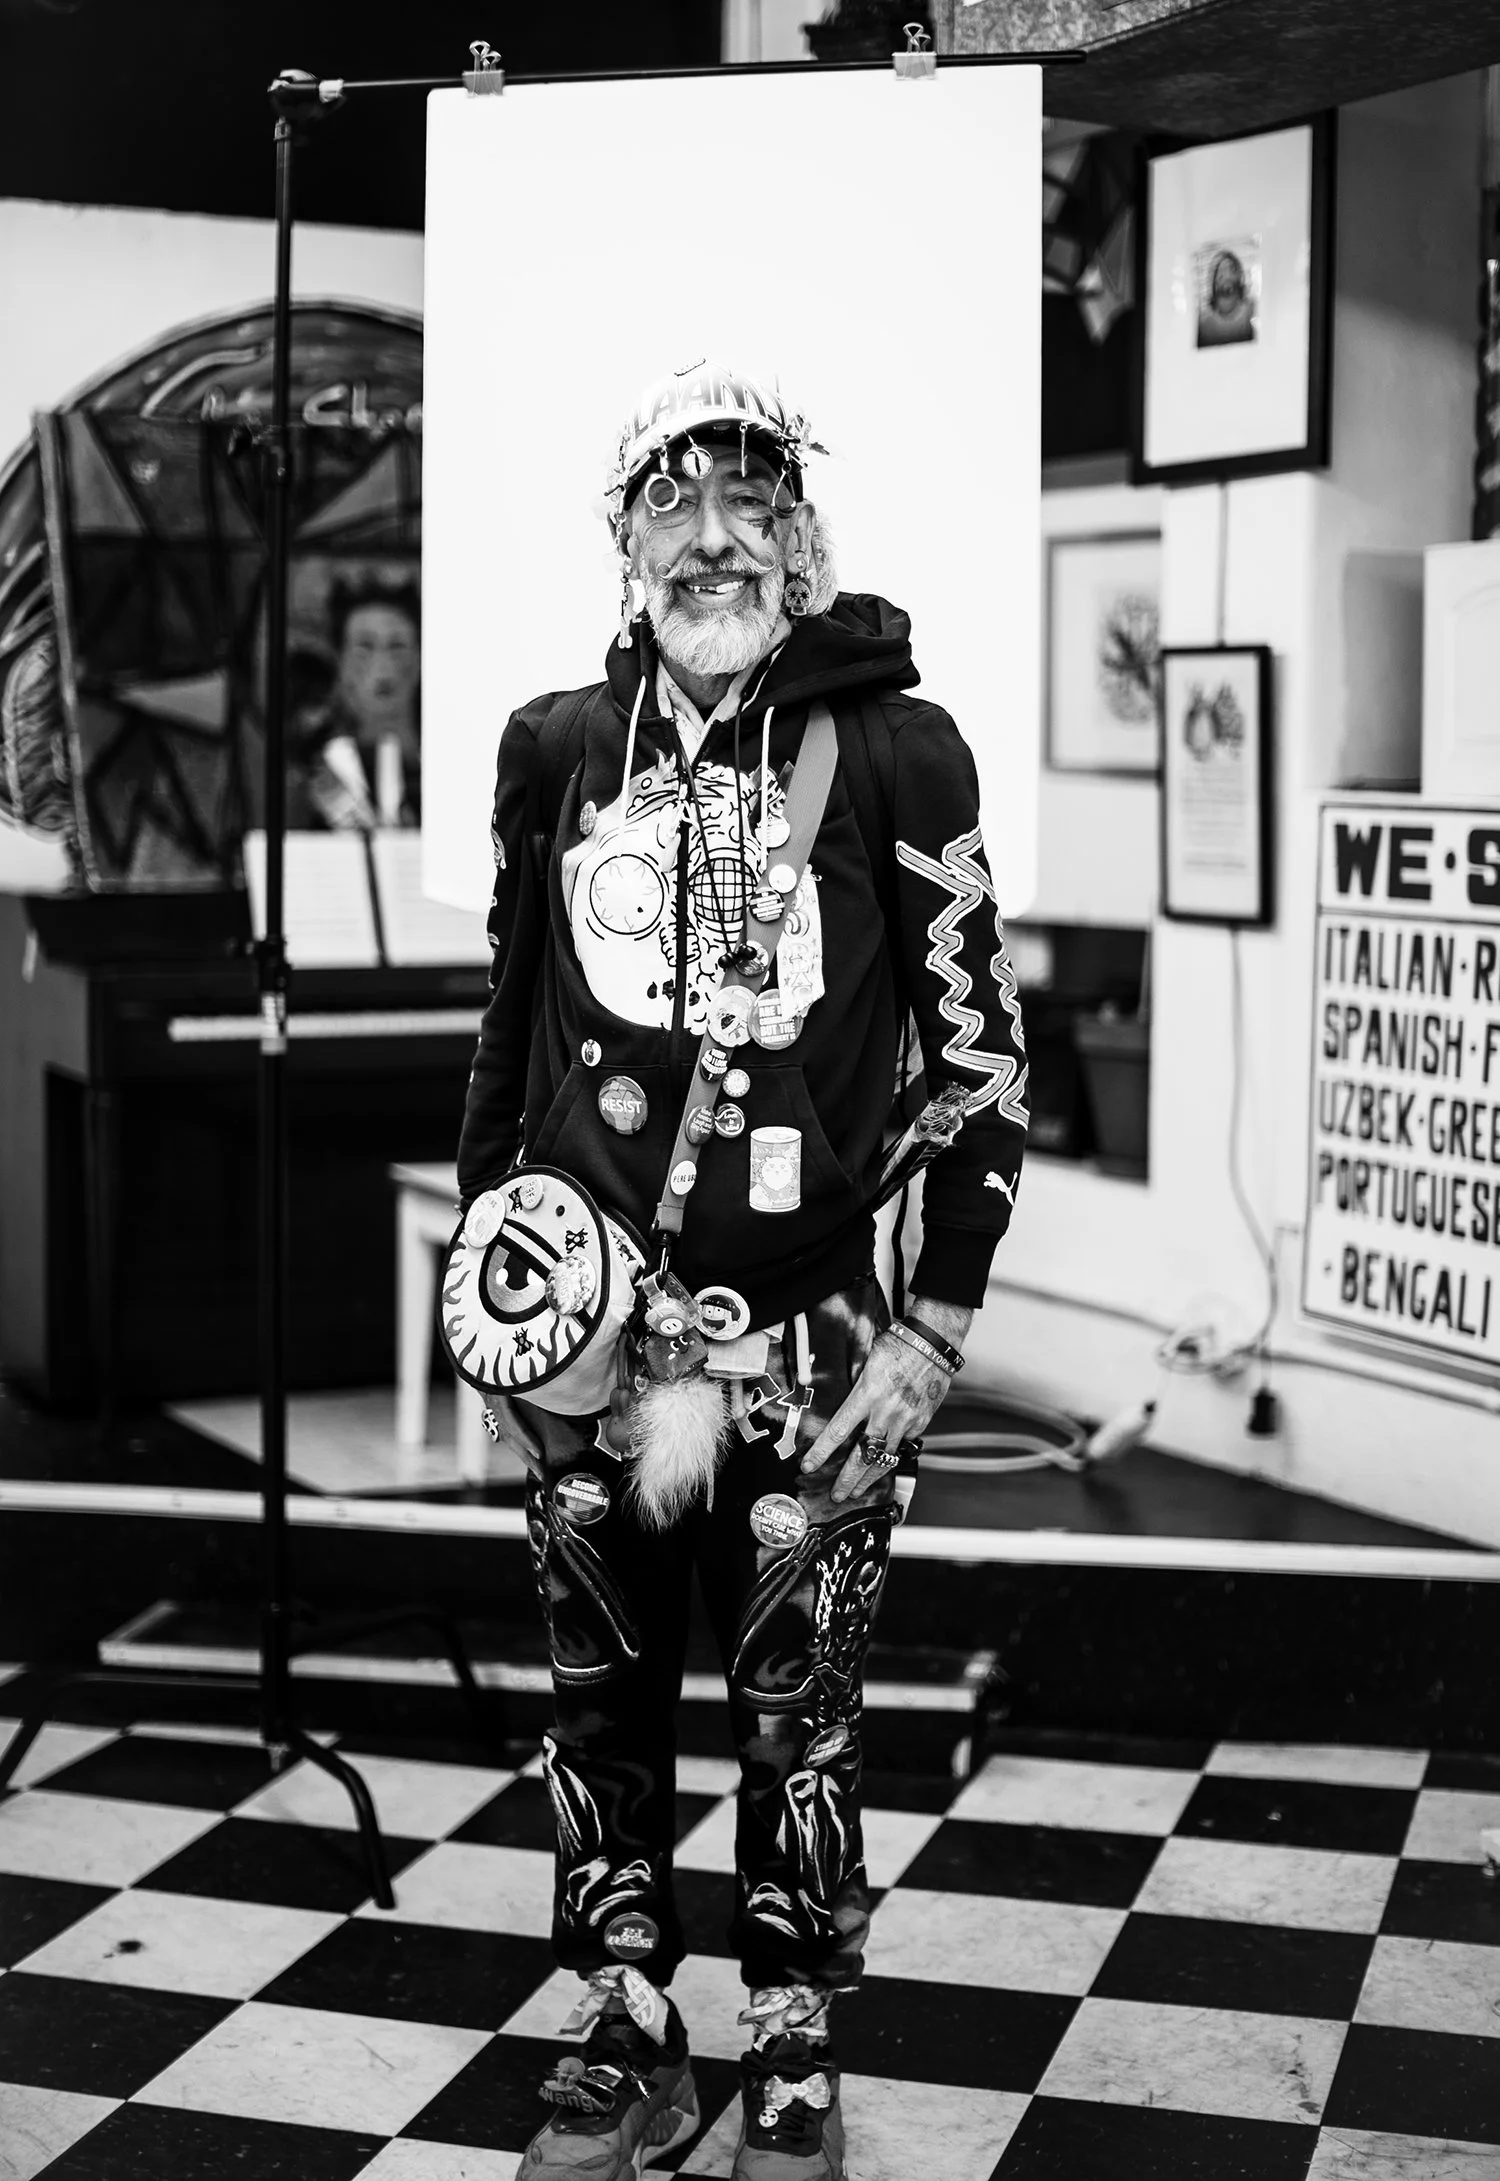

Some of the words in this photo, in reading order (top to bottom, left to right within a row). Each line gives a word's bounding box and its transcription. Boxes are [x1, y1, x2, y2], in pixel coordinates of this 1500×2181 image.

[601, 1098, 643, 1114] RESIST
[911, 1337, 934, 1357] NEW
[931, 1350, 951, 1371] YORK
[571, 1479, 601, 1495] BECOME
[755, 1501, 805, 1530] SCIENCE
